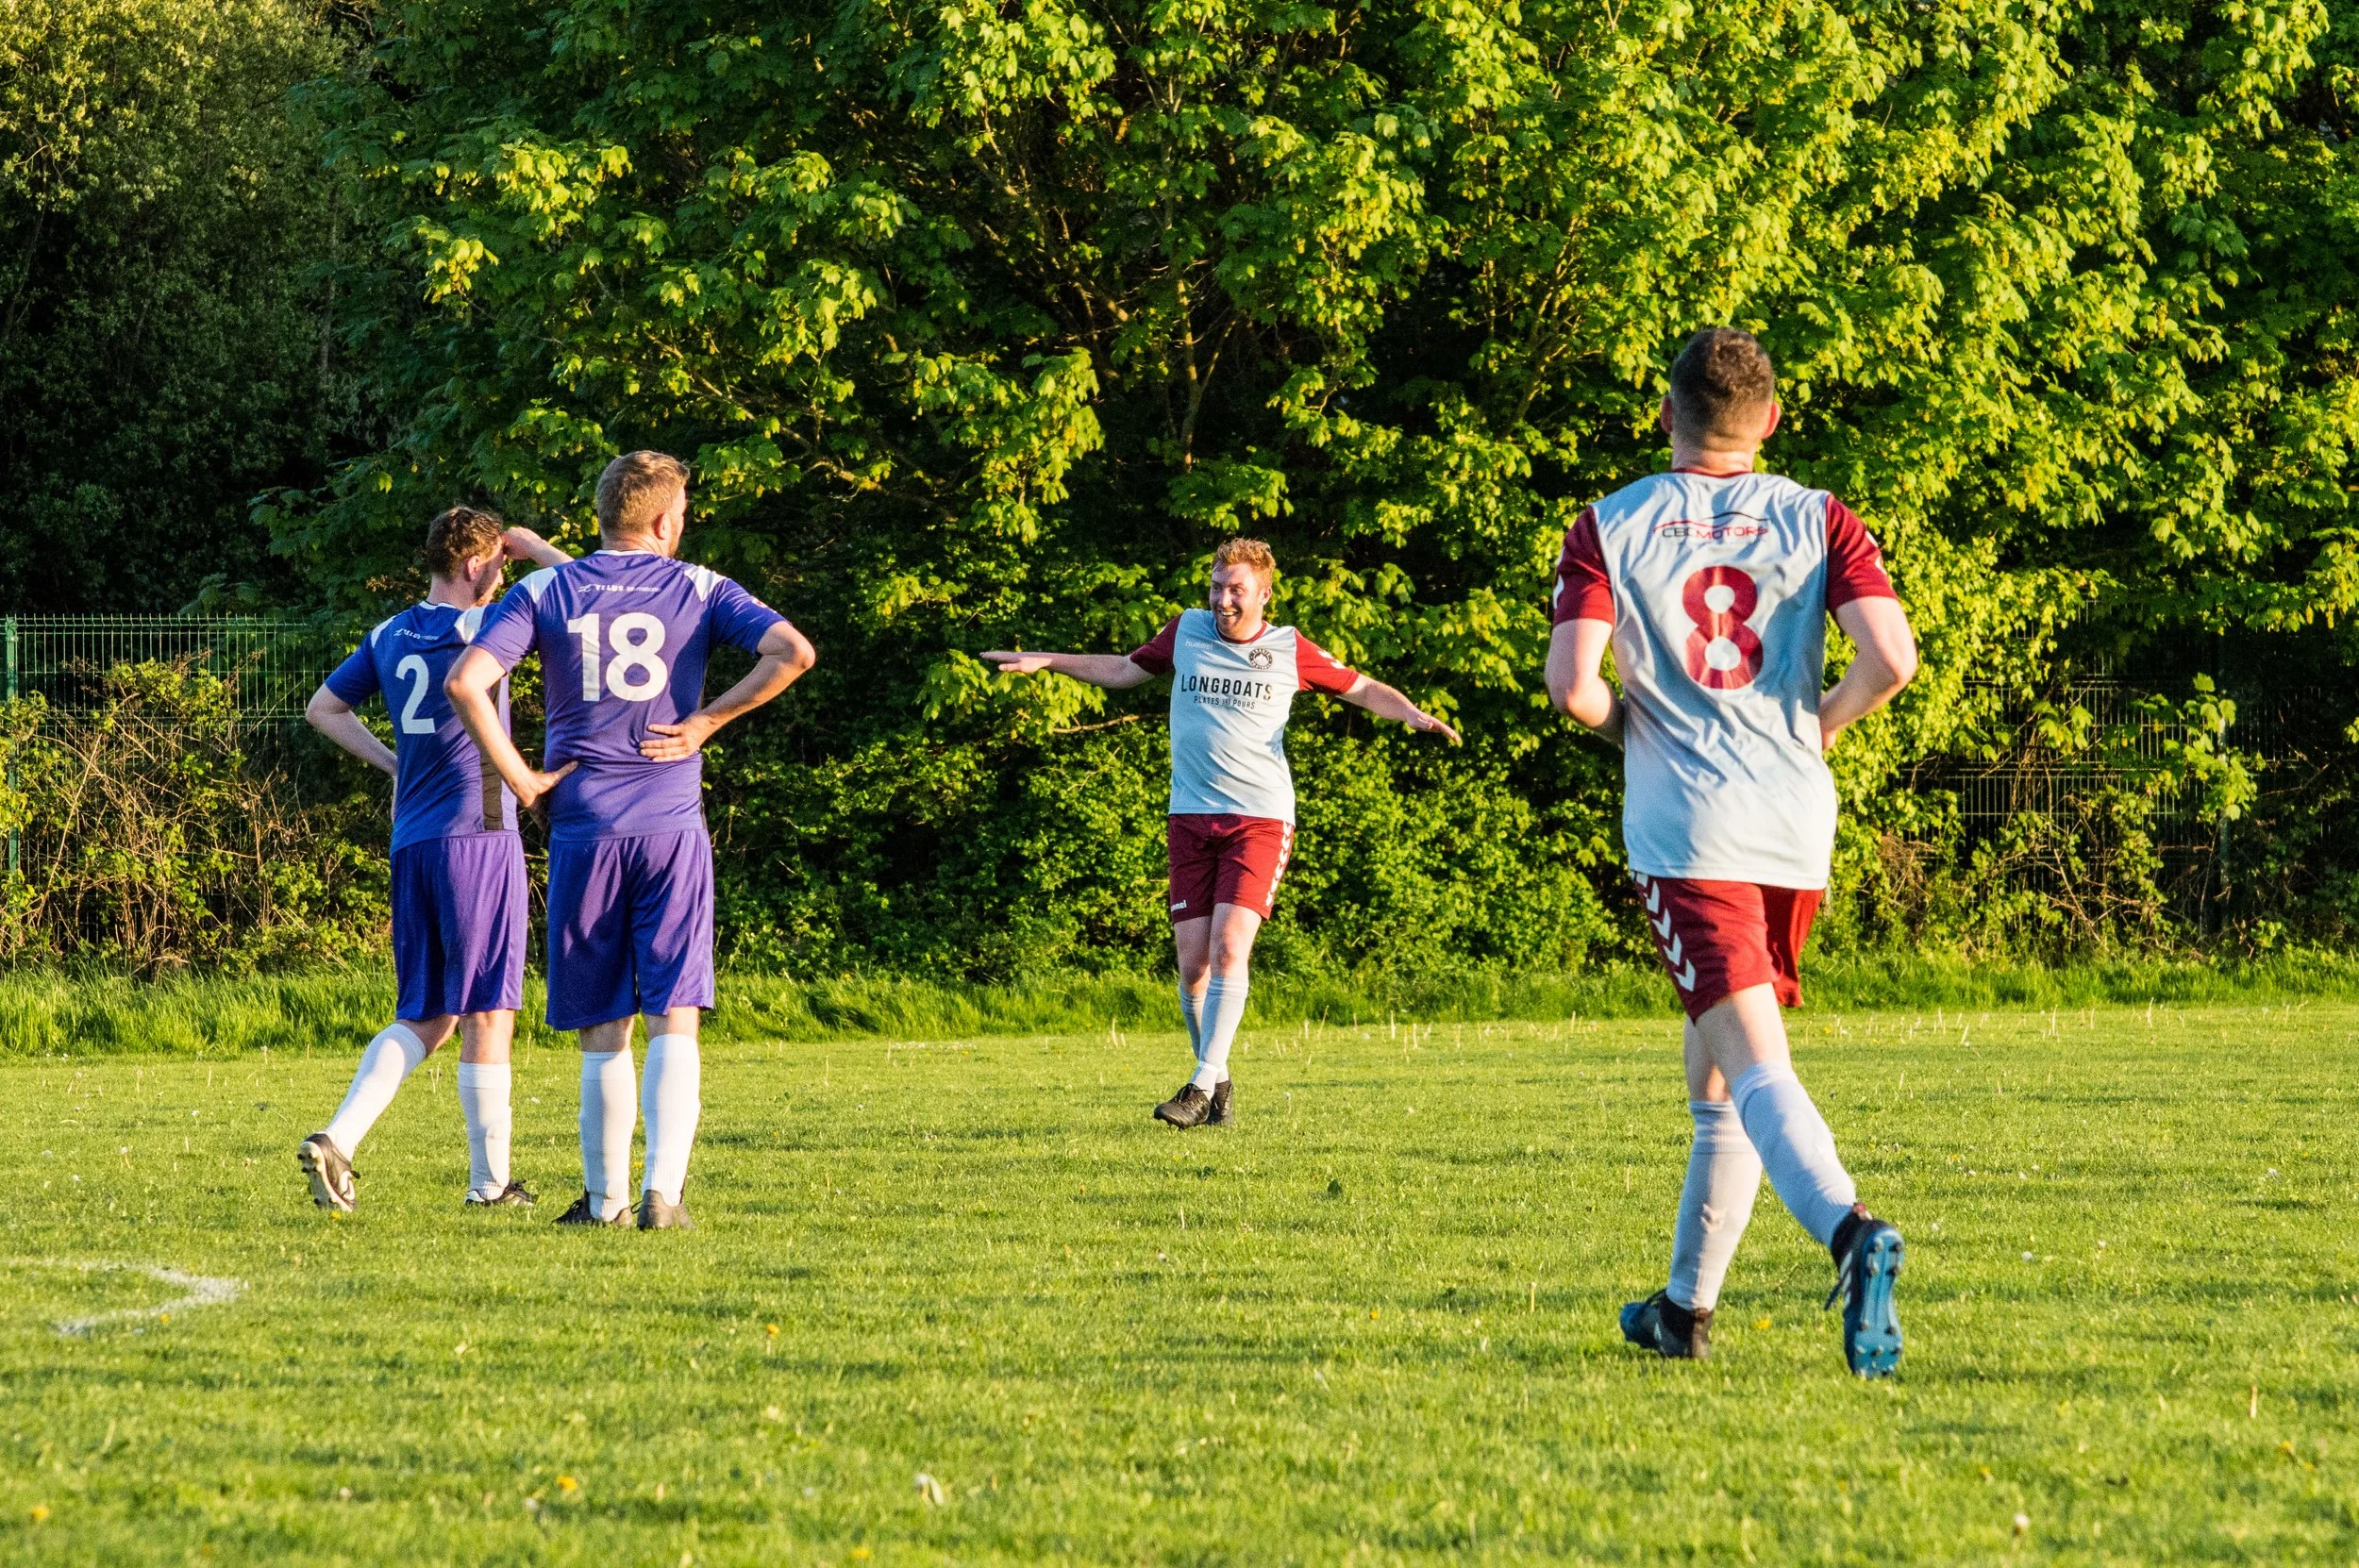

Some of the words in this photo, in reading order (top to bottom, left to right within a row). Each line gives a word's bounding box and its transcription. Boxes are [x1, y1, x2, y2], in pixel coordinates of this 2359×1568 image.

[567, 612, 667, 701] 18
[1682, 565, 1764, 690] 8
[395, 654, 435, 734] 2
[1181, 674, 1272, 701] LONGBOATS
[1194, 695, 1219, 706] PLATES
[1233, 699, 1256, 709] POURS
